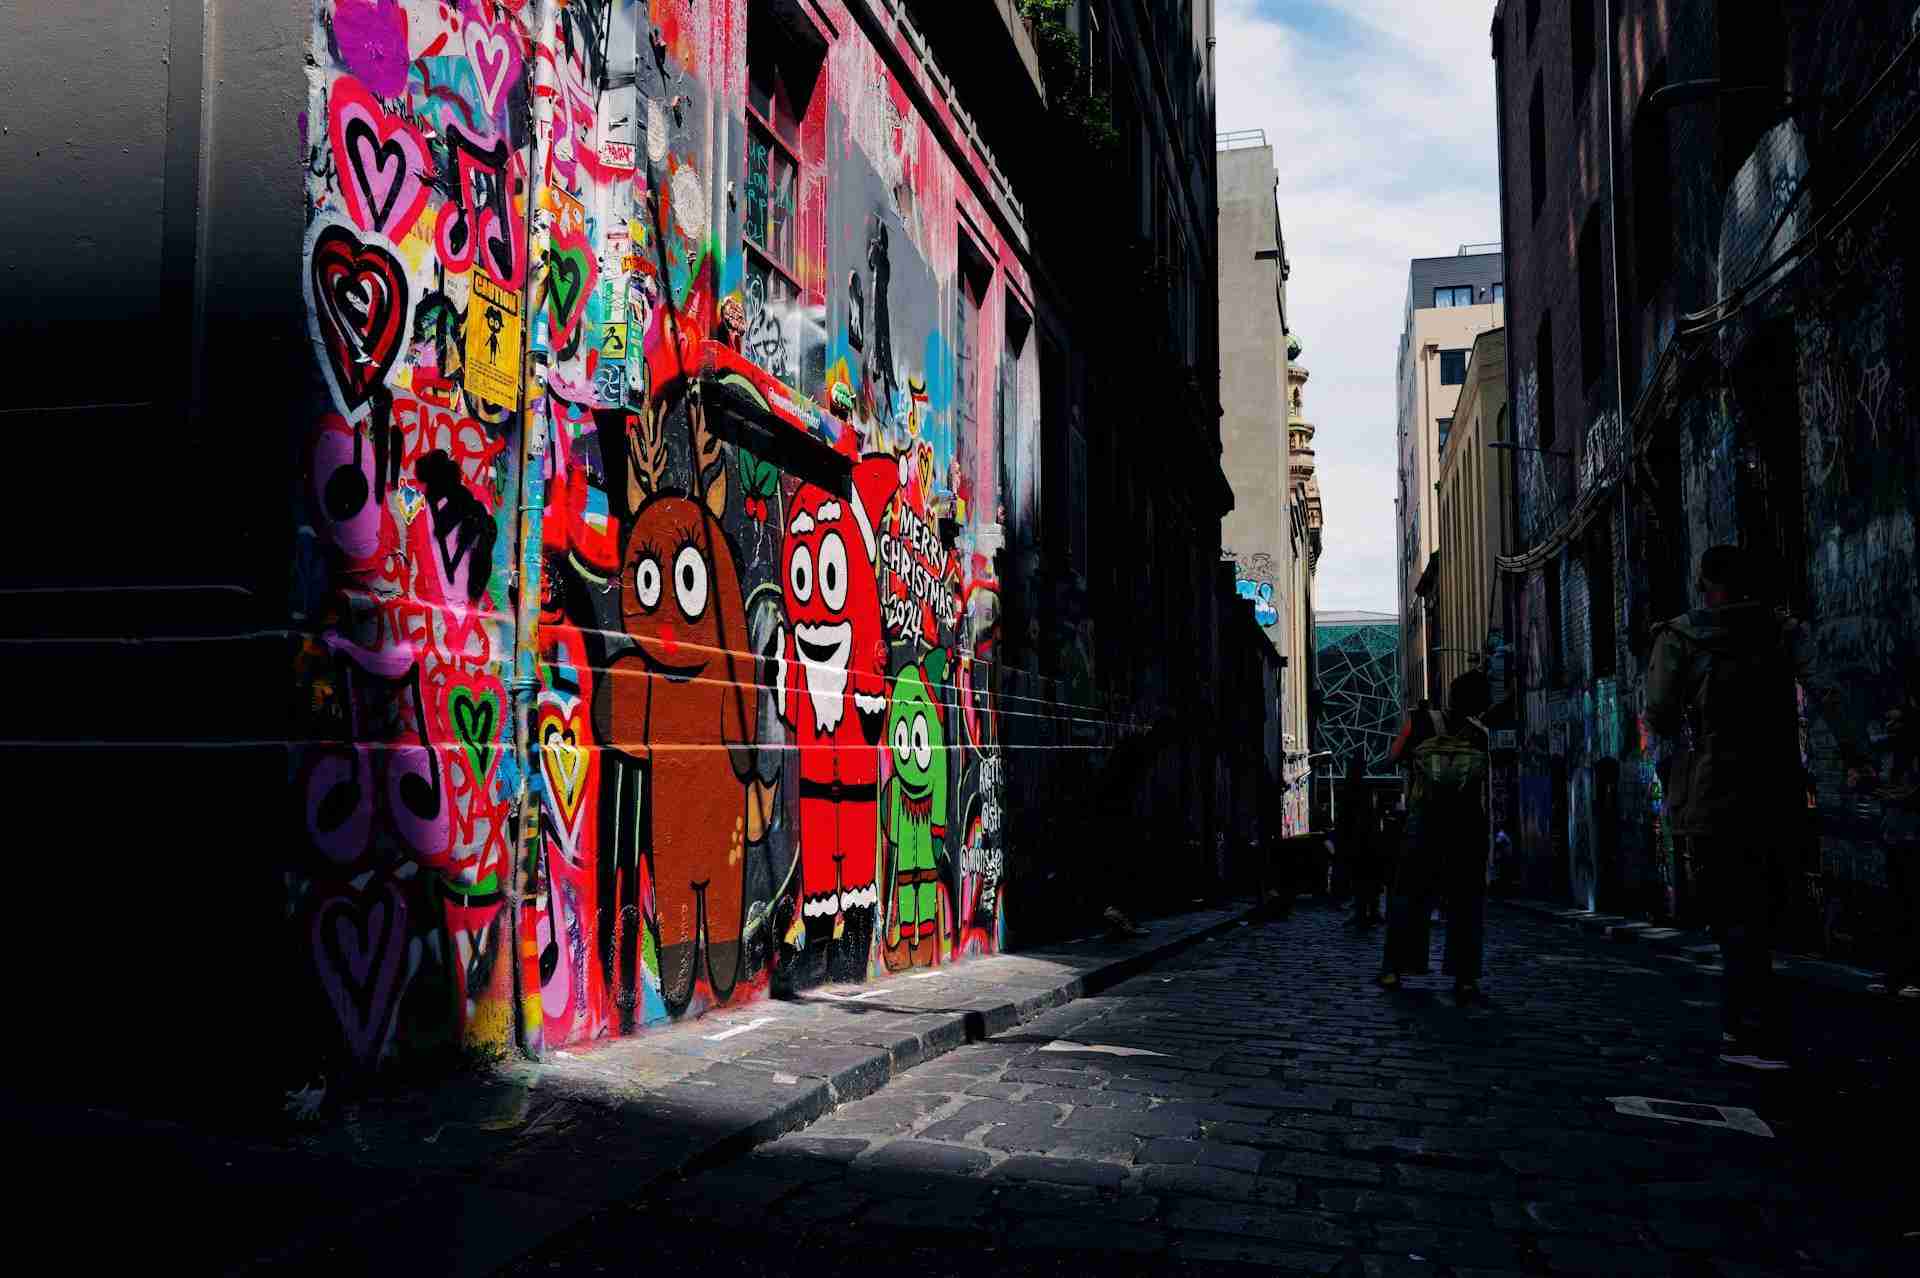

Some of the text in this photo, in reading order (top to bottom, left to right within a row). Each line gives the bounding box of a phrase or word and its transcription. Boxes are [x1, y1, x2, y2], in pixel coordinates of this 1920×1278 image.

[476, 274, 516, 313] CAUTION
[900, 504, 948, 579] MERRY
[880, 534, 954, 631] CHRISTMAS
[887, 595, 923, 646] 2024
